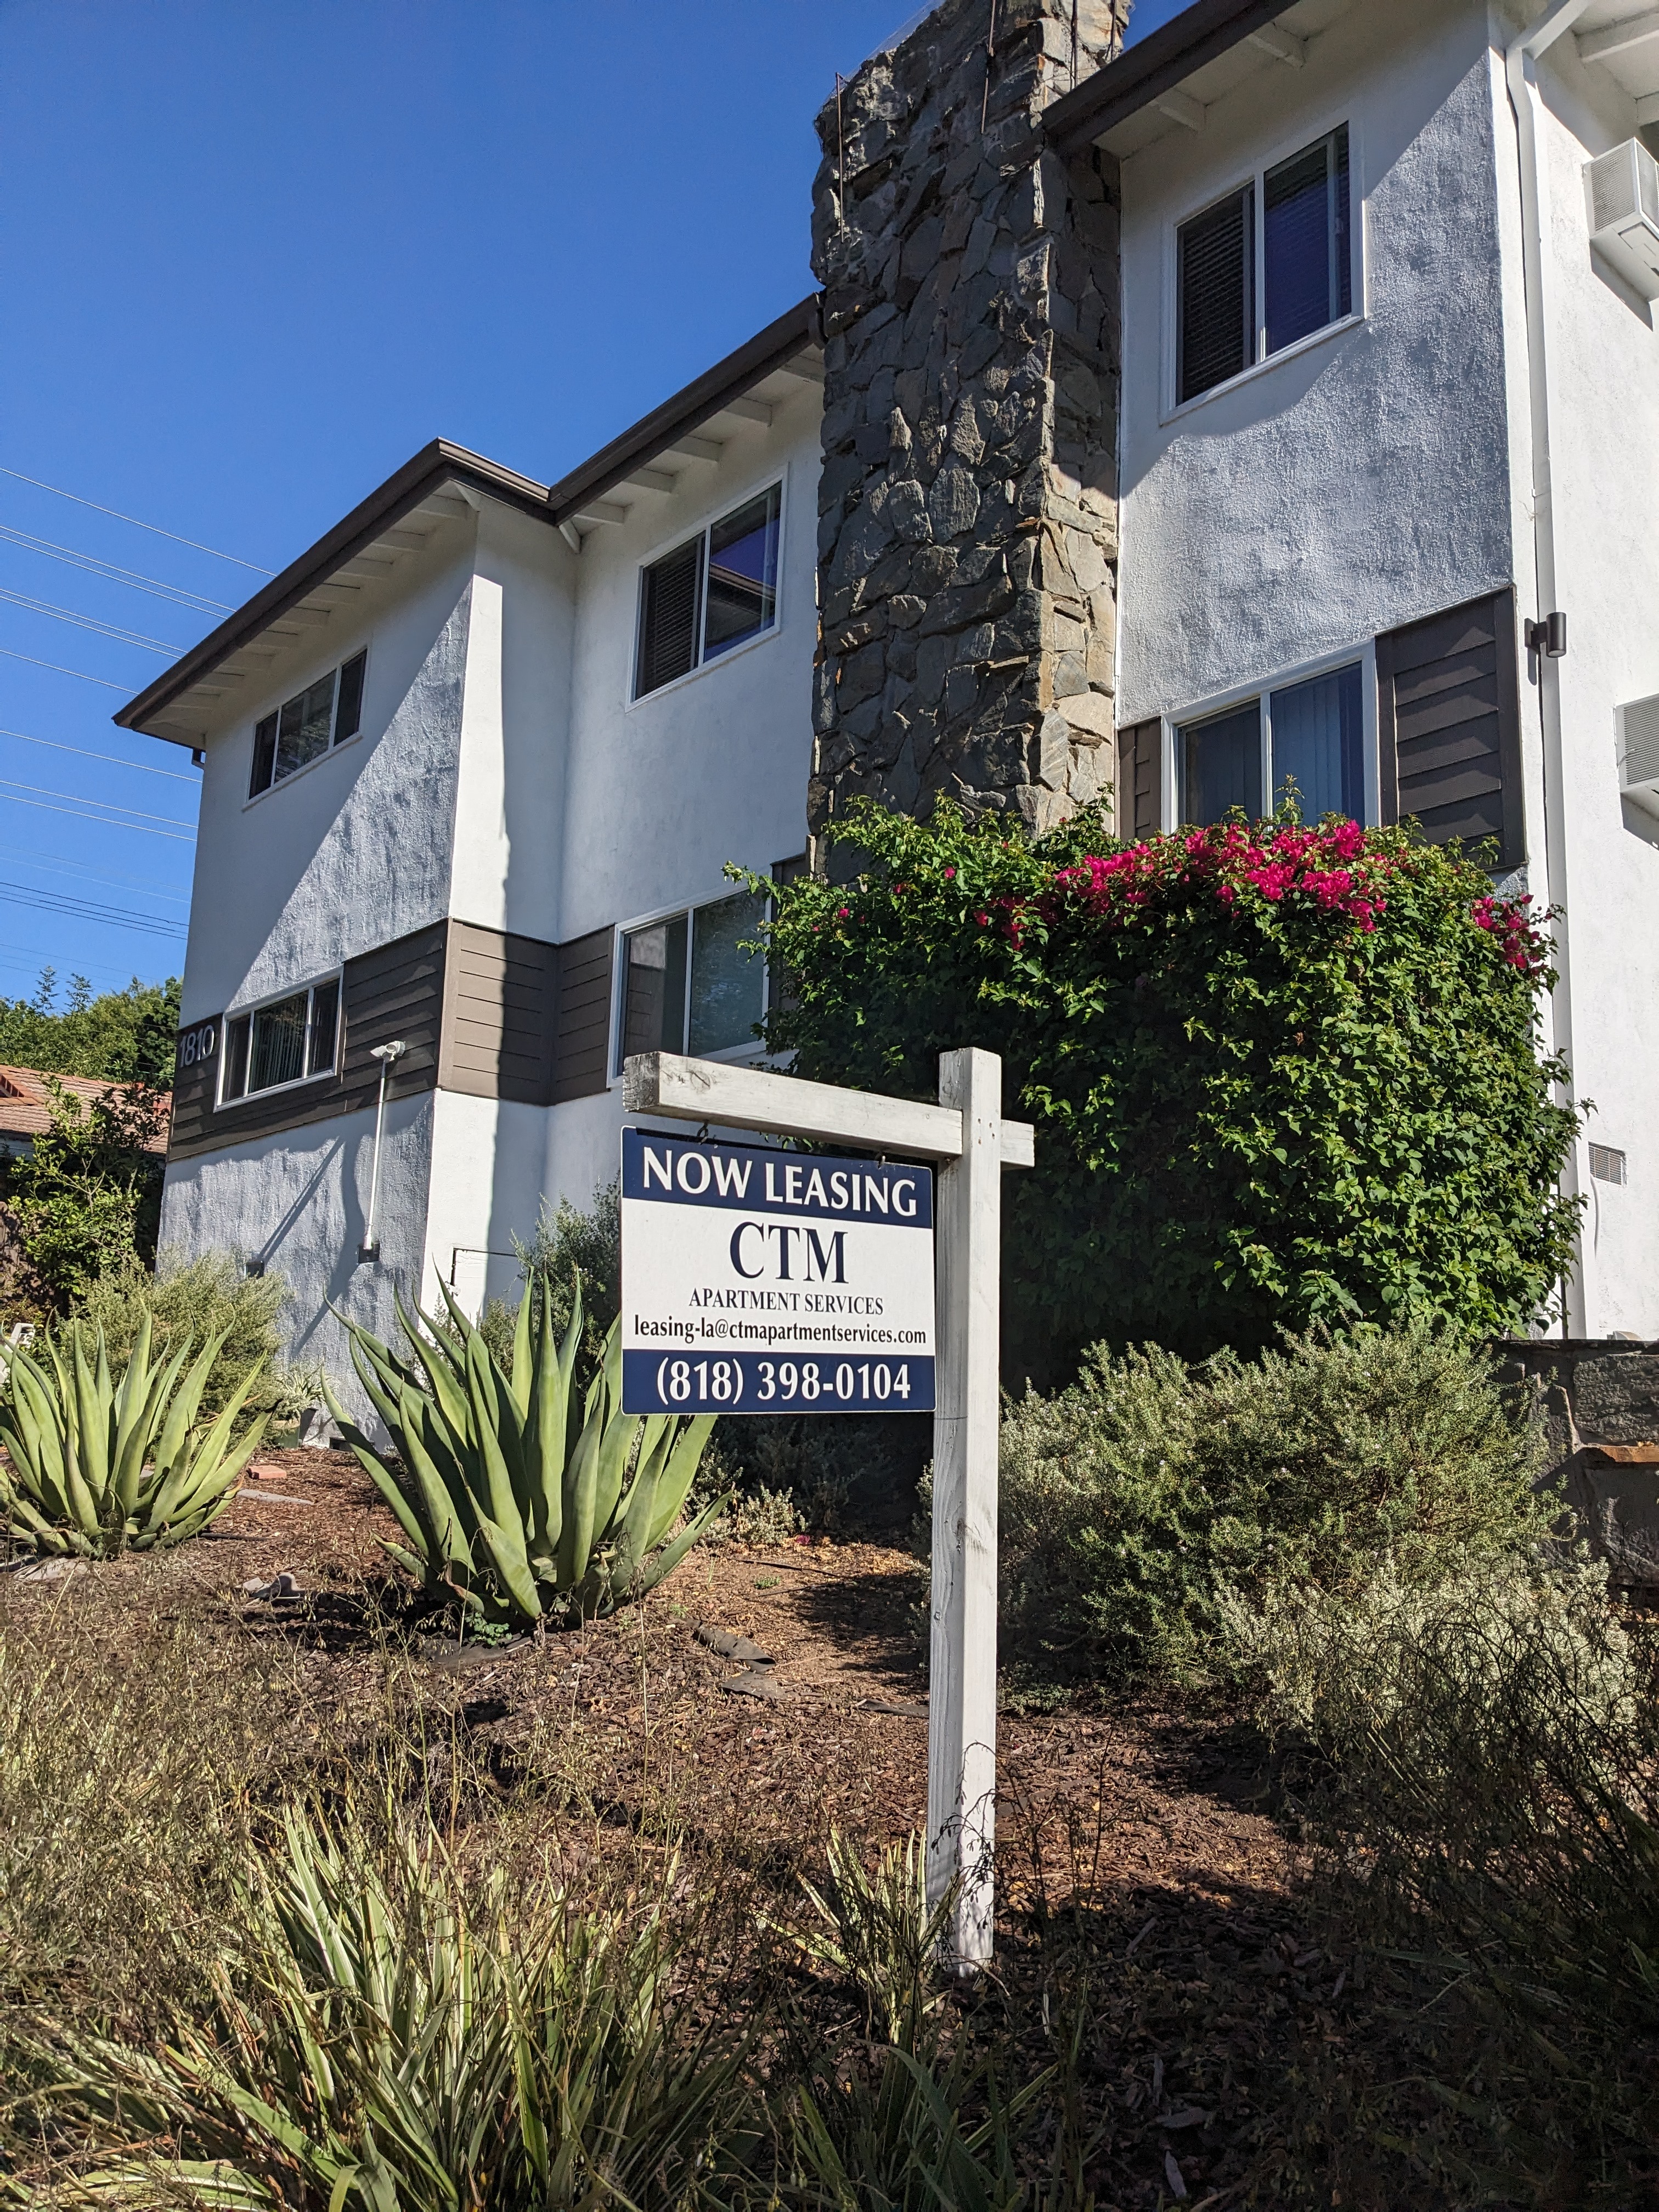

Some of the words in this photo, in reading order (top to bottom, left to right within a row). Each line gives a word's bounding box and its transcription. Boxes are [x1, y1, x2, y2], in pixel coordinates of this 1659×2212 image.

[180, 1025, 215, 1068] 1810
[643, 1147, 753, 1198] NOW
[765, 1162, 917, 1217] LEASING
[730, 1221, 849, 1284] CTM
[689, 1288, 800, 1312] APARTMENT
[805, 1293, 884, 1315] SERVICES
[634, 1314, 927, 1345] leasing-la@ctmapartmentservices.com
[658, 1357, 743, 1405] (818)
[757, 1362, 911, 1401] 398-0104
